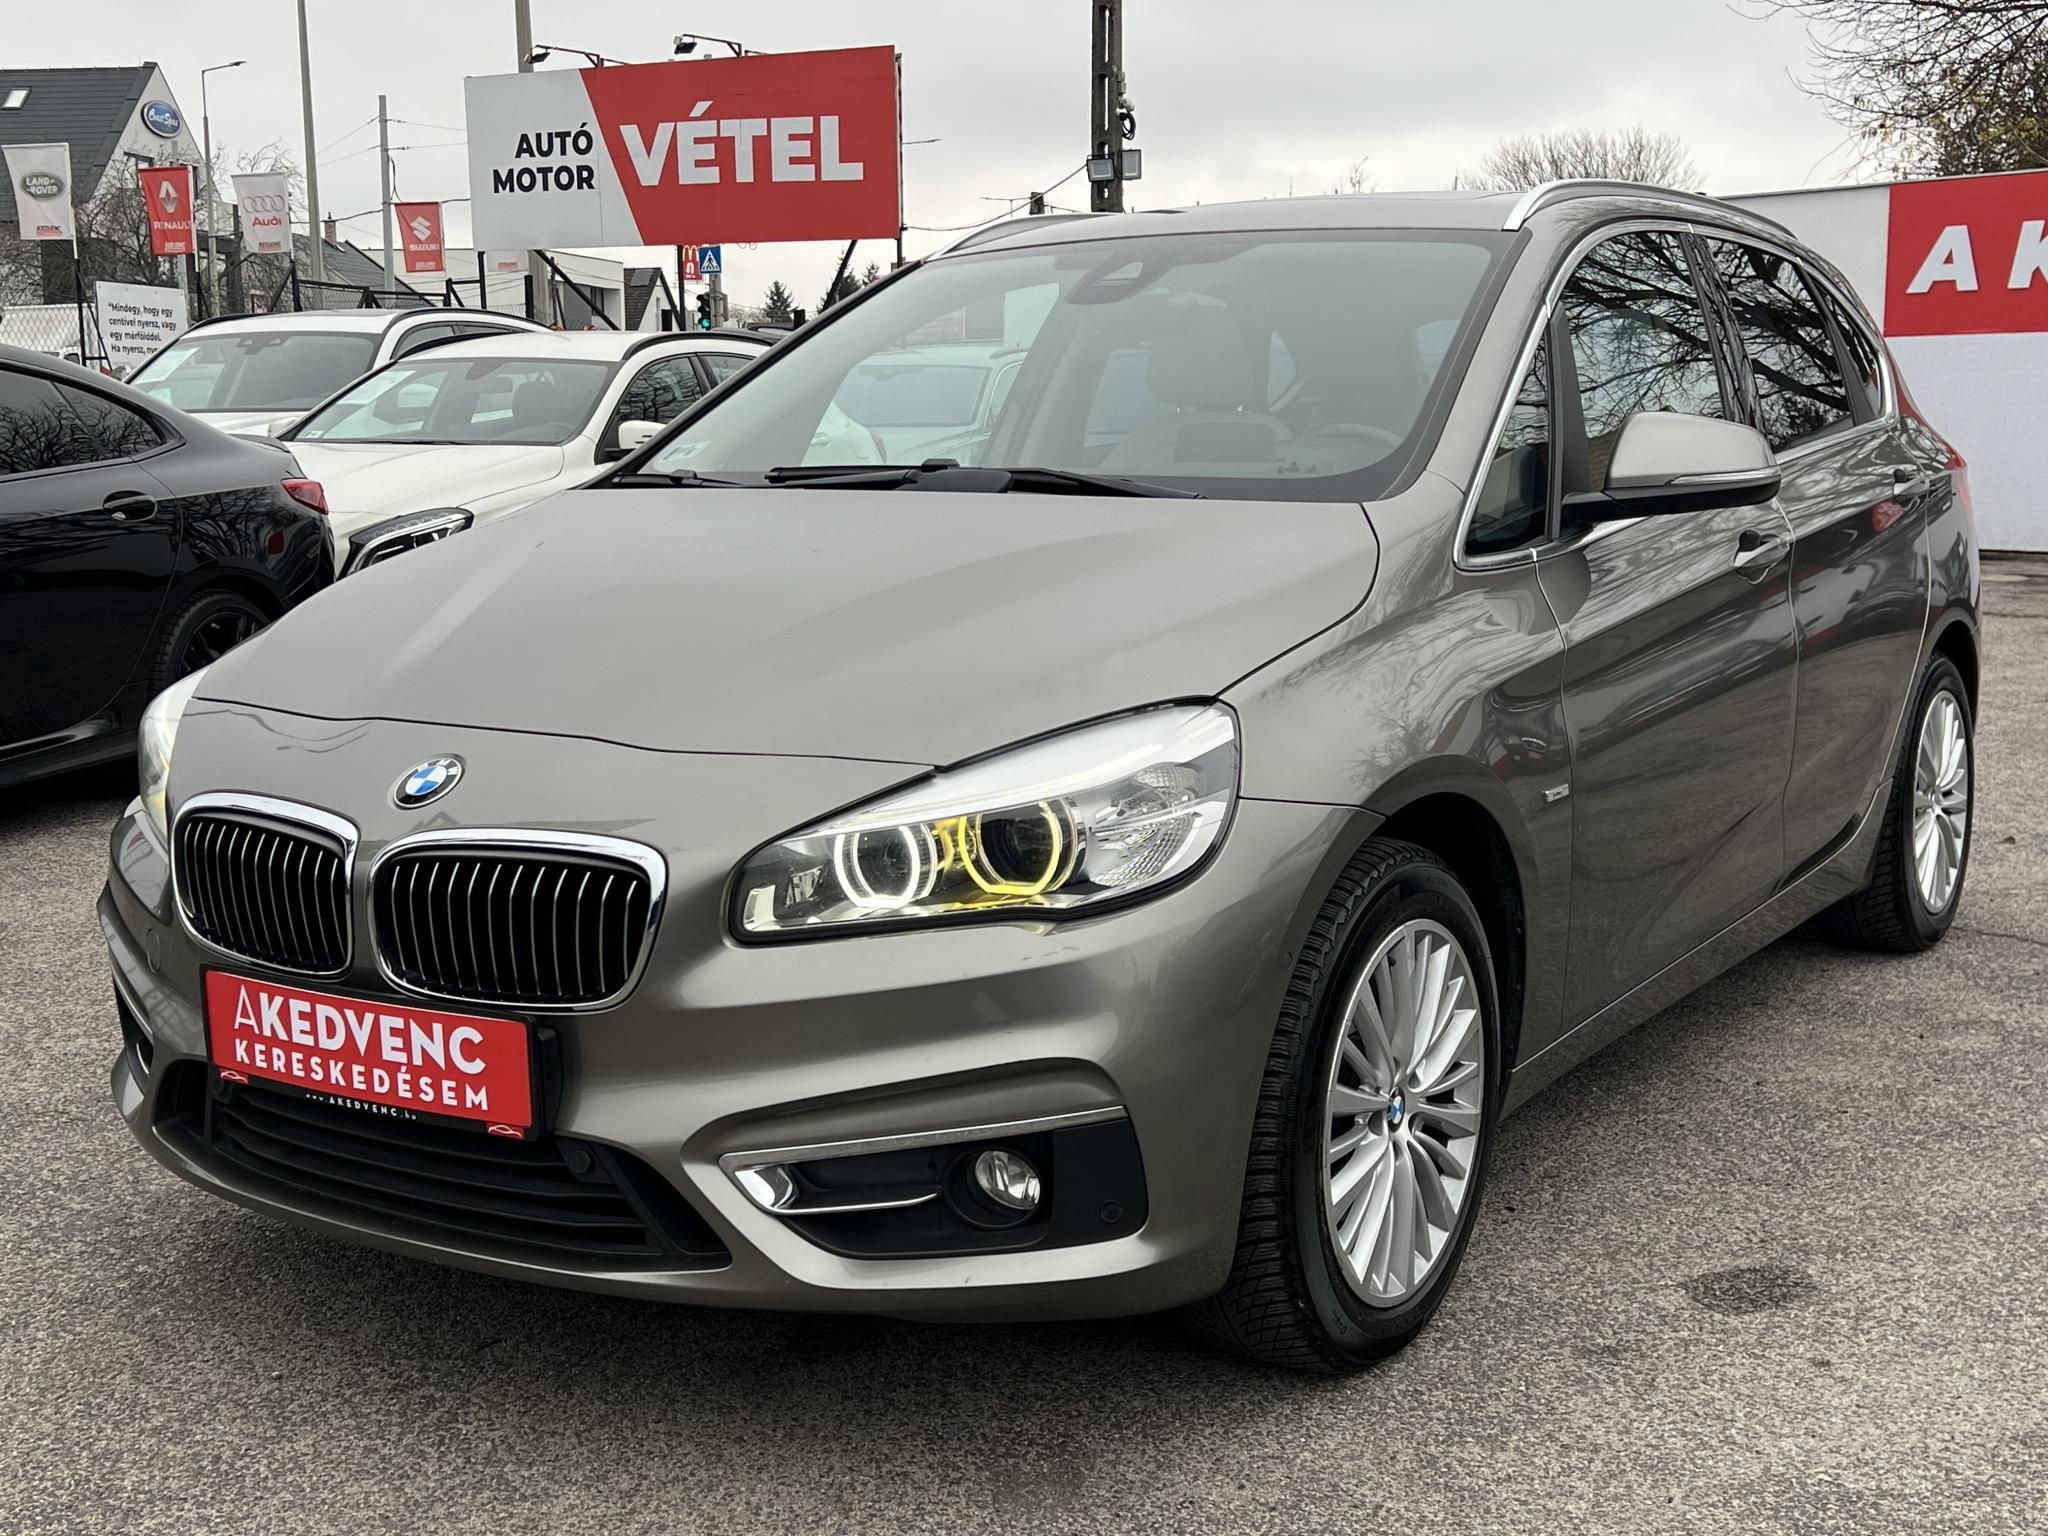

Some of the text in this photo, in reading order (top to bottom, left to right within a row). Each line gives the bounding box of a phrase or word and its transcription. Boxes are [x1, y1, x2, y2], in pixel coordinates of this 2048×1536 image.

[515, 122, 594, 159] AUTÓ
[619, 100, 864, 187] VÉTEL
[493, 165, 595, 194] MOTOR
[252, 216, 282, 226] Audi
[409, 243, 440, 251] SUZUKI
[143, 305, 159, 317] hogy
[161, 308, 173, 318] egy
[162, 321, 177, 331] vagy
[110, 331, 122, 341] egy
[111, 344, 121, 352] Ha
[233, 984, 486, 1075] AKEDVENC
[235, 1038, 489, 1112] KERESKEDÉSEM
